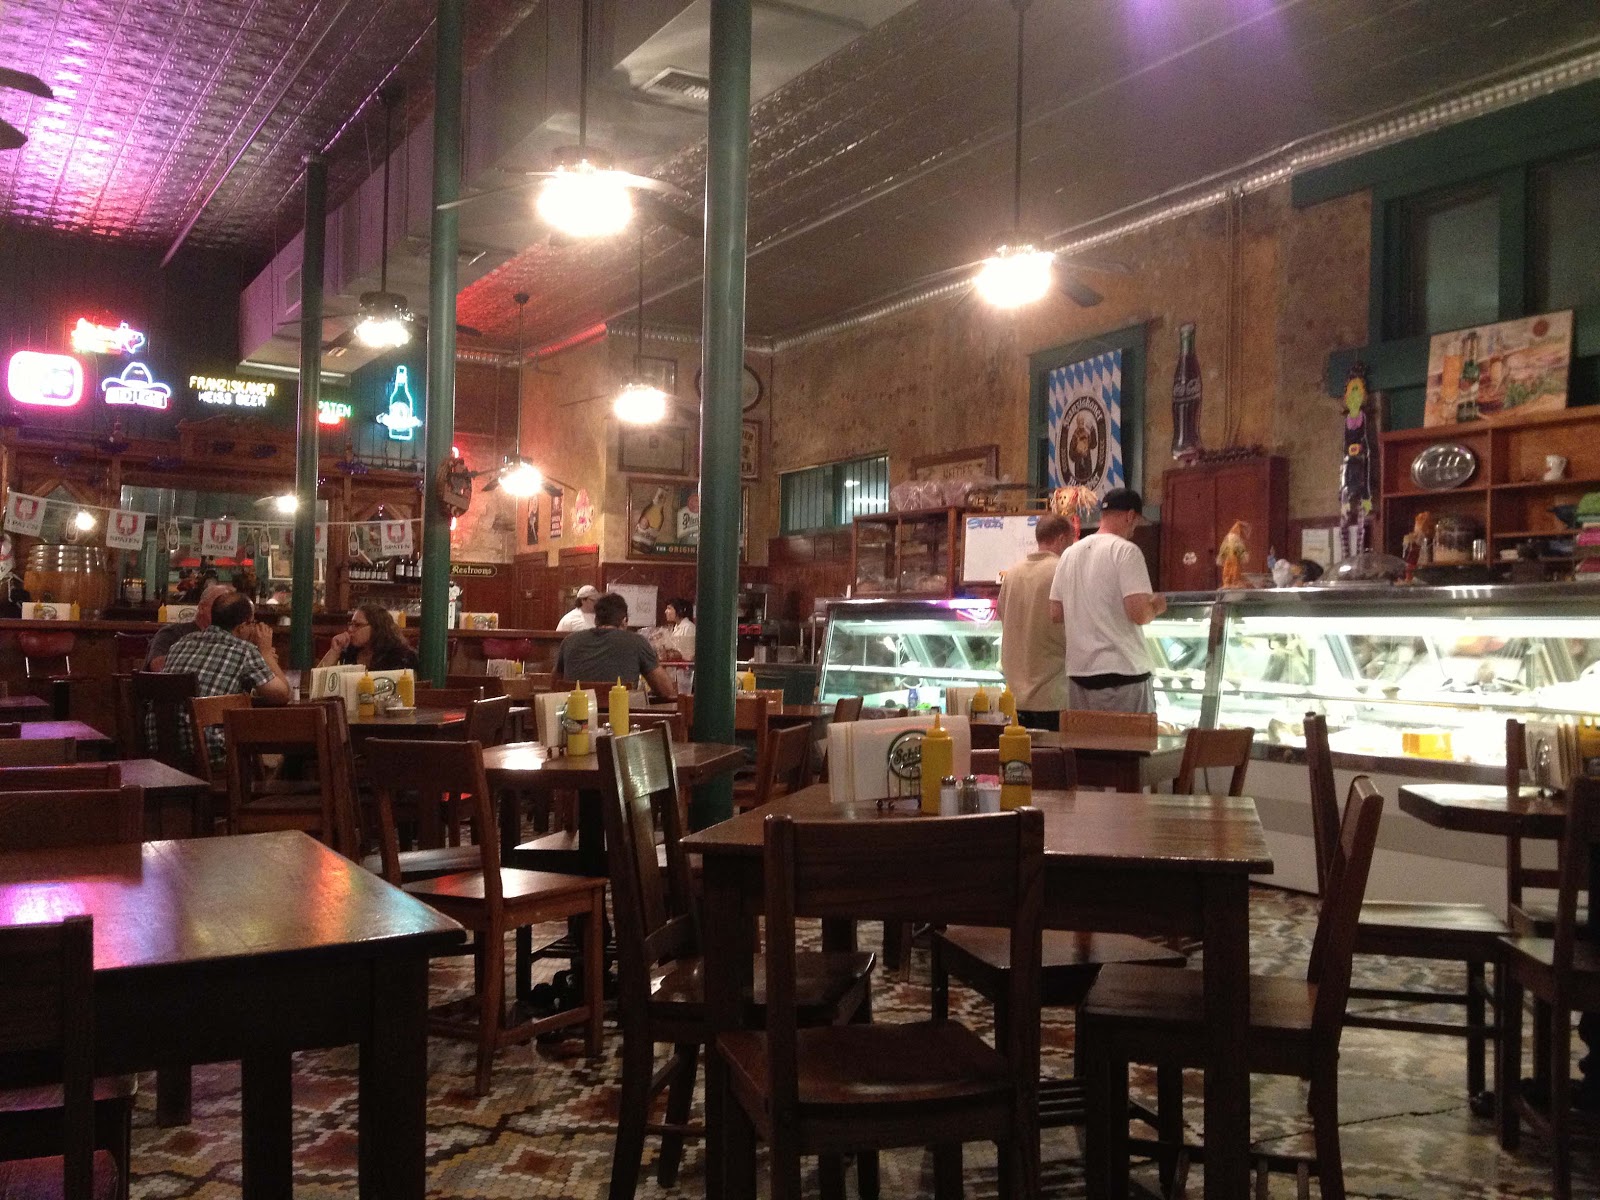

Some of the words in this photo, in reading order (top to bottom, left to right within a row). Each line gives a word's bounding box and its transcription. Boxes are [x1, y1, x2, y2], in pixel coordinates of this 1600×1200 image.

[188, 375, 276, 397] FRANZISKANER
[318, 400, 352, 418] PATEN
[205, 543, 235, 552] SPATEN
[384, 543, 411, 552] SPATEN
[668, 546, 697, 554] ORIGIN
[451, 564, 493, 576] Restrooms
